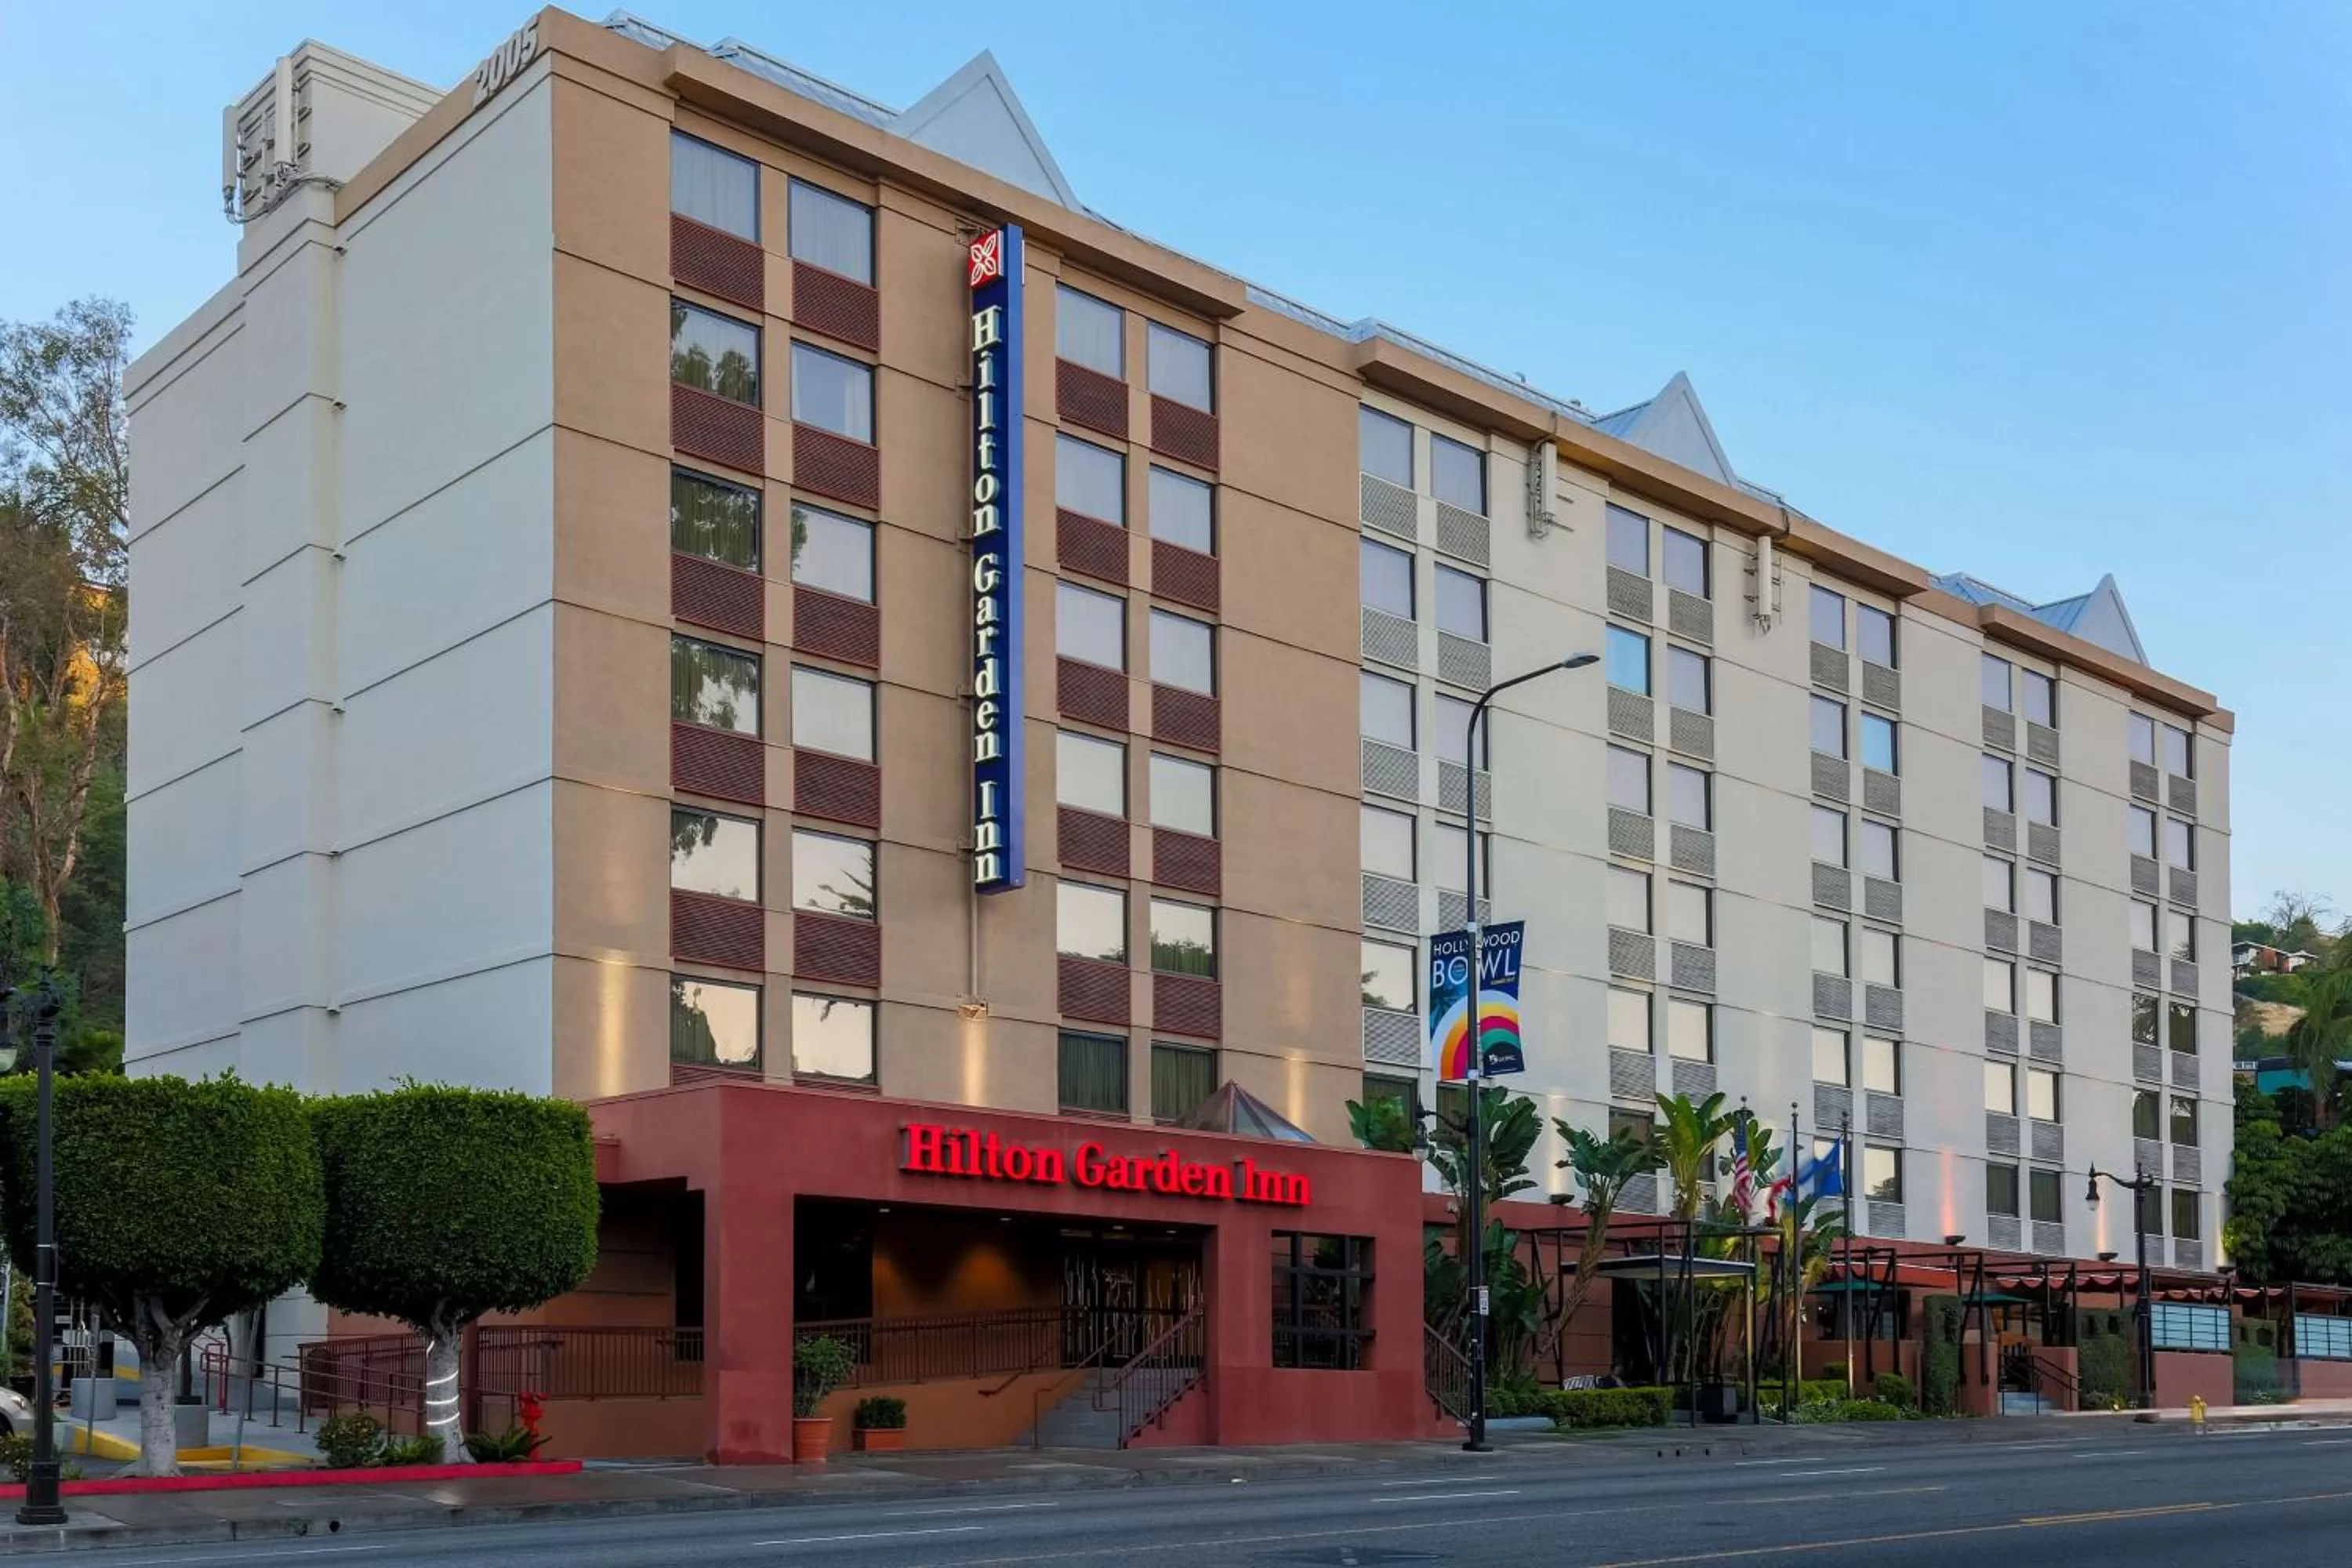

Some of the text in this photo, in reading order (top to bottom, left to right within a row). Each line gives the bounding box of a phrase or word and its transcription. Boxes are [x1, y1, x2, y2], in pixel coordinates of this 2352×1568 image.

[473, 12, 541, 110] 2005
[972, 306, 1003, 884] Hilton Garden Inn
[906, 1123, 1311, 1205] Hilton Garden Inn
